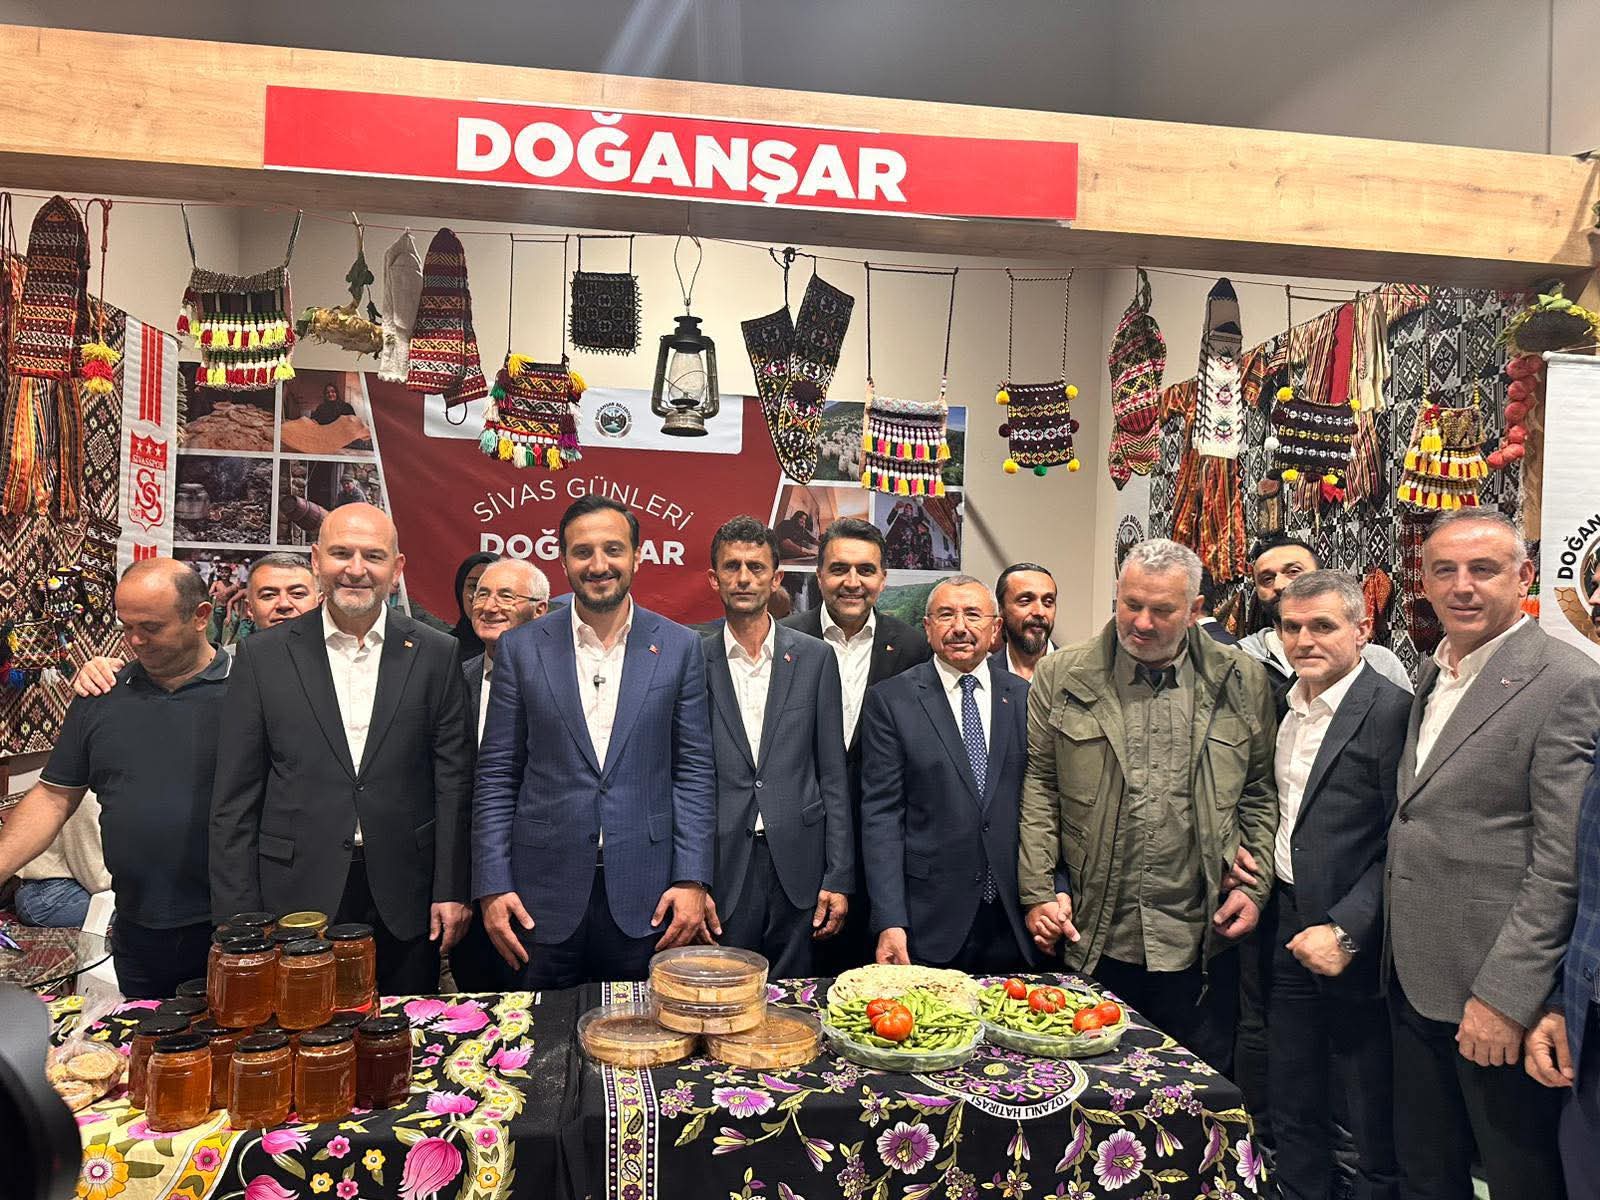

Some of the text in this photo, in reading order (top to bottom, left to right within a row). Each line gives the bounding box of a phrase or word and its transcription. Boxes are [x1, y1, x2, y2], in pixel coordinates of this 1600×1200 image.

[455, 110, 908, 206] DOĞANŞAR
[473, 476, 695, 531] SİVAS GÜNLERİ
[479, 528, 685, 565] DOĞAR
[971, 1095, 1070, 1117] TOZANLI HATIRASI
